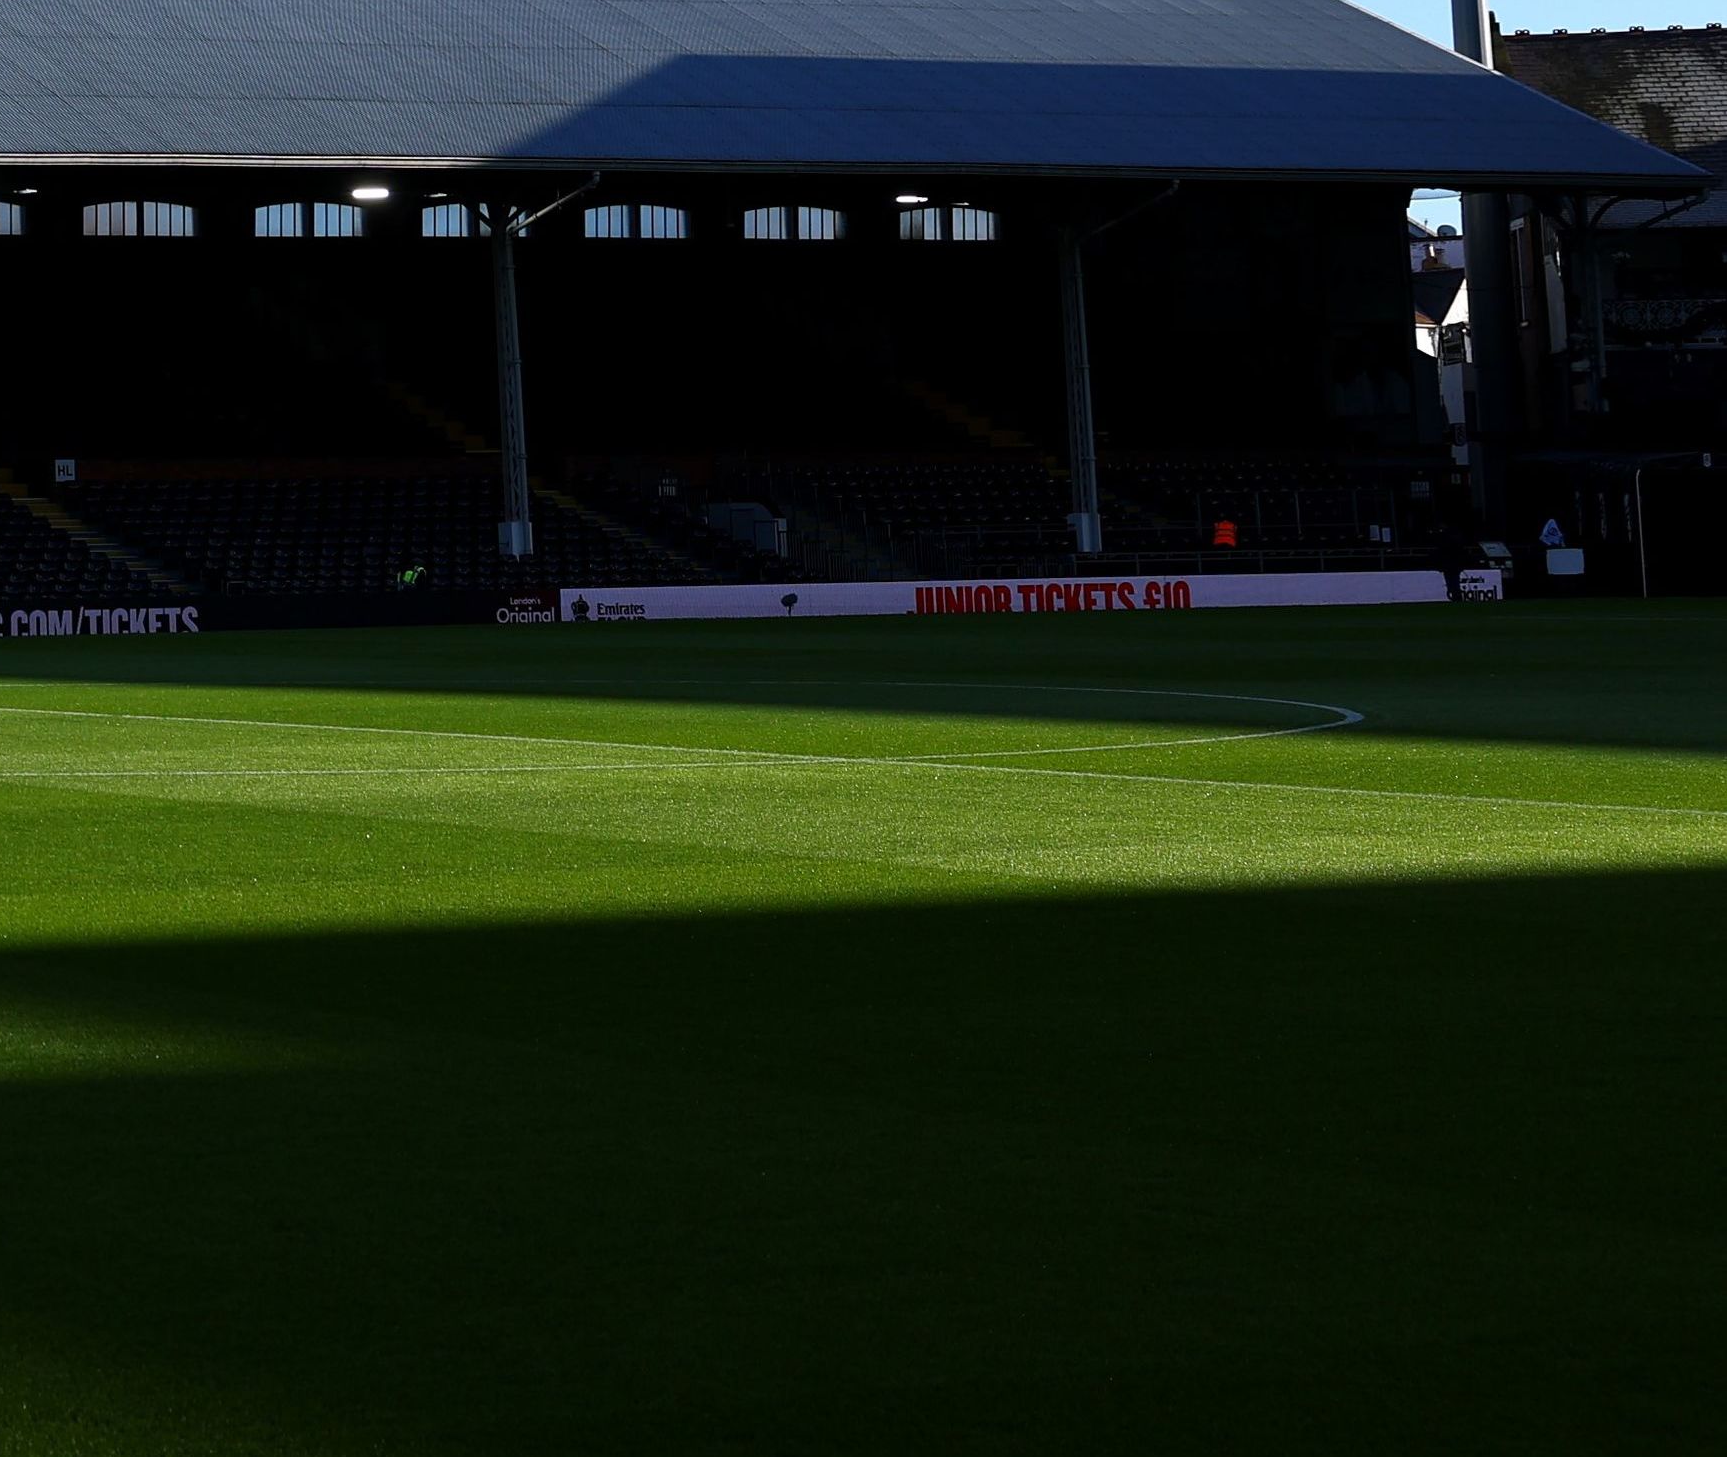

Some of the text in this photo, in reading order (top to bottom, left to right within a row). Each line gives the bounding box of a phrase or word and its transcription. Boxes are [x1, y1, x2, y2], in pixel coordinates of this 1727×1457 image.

[58, 465, 73, 476] HL
[906, 580, 1191, 615] JUNIOR TICKETS £10
[496, 606, 555, 624] Original
[597, 603, 645, 616] Emirates
